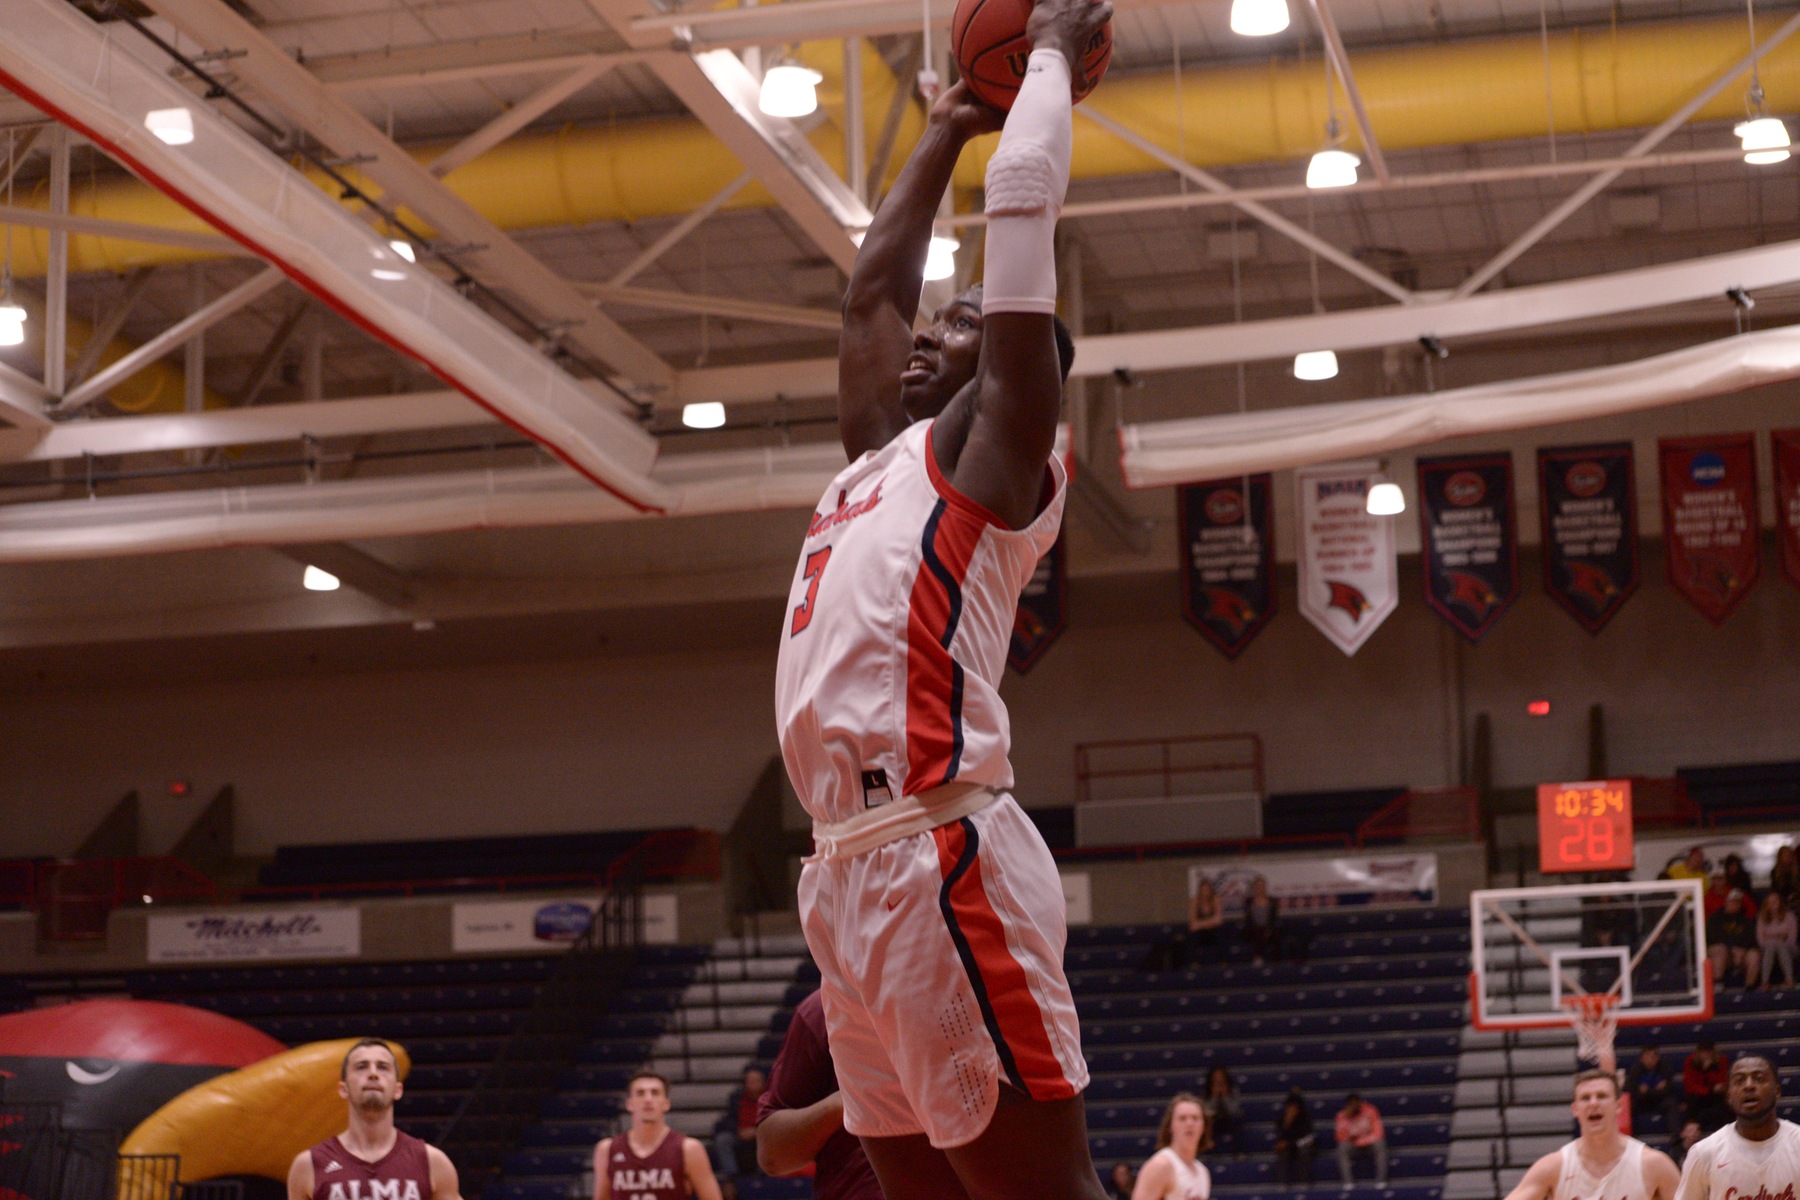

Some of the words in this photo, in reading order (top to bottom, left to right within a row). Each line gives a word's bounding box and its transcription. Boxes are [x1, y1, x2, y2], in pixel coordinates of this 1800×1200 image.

[791, 545, 832, 638] 3
[1555, 788, 1624, 818] 10:34
[1560, 816, 1614, 862] 28
[327, 1178, 422, 1200] ALMA
[612, 1168, 676, 1191] ALMA
